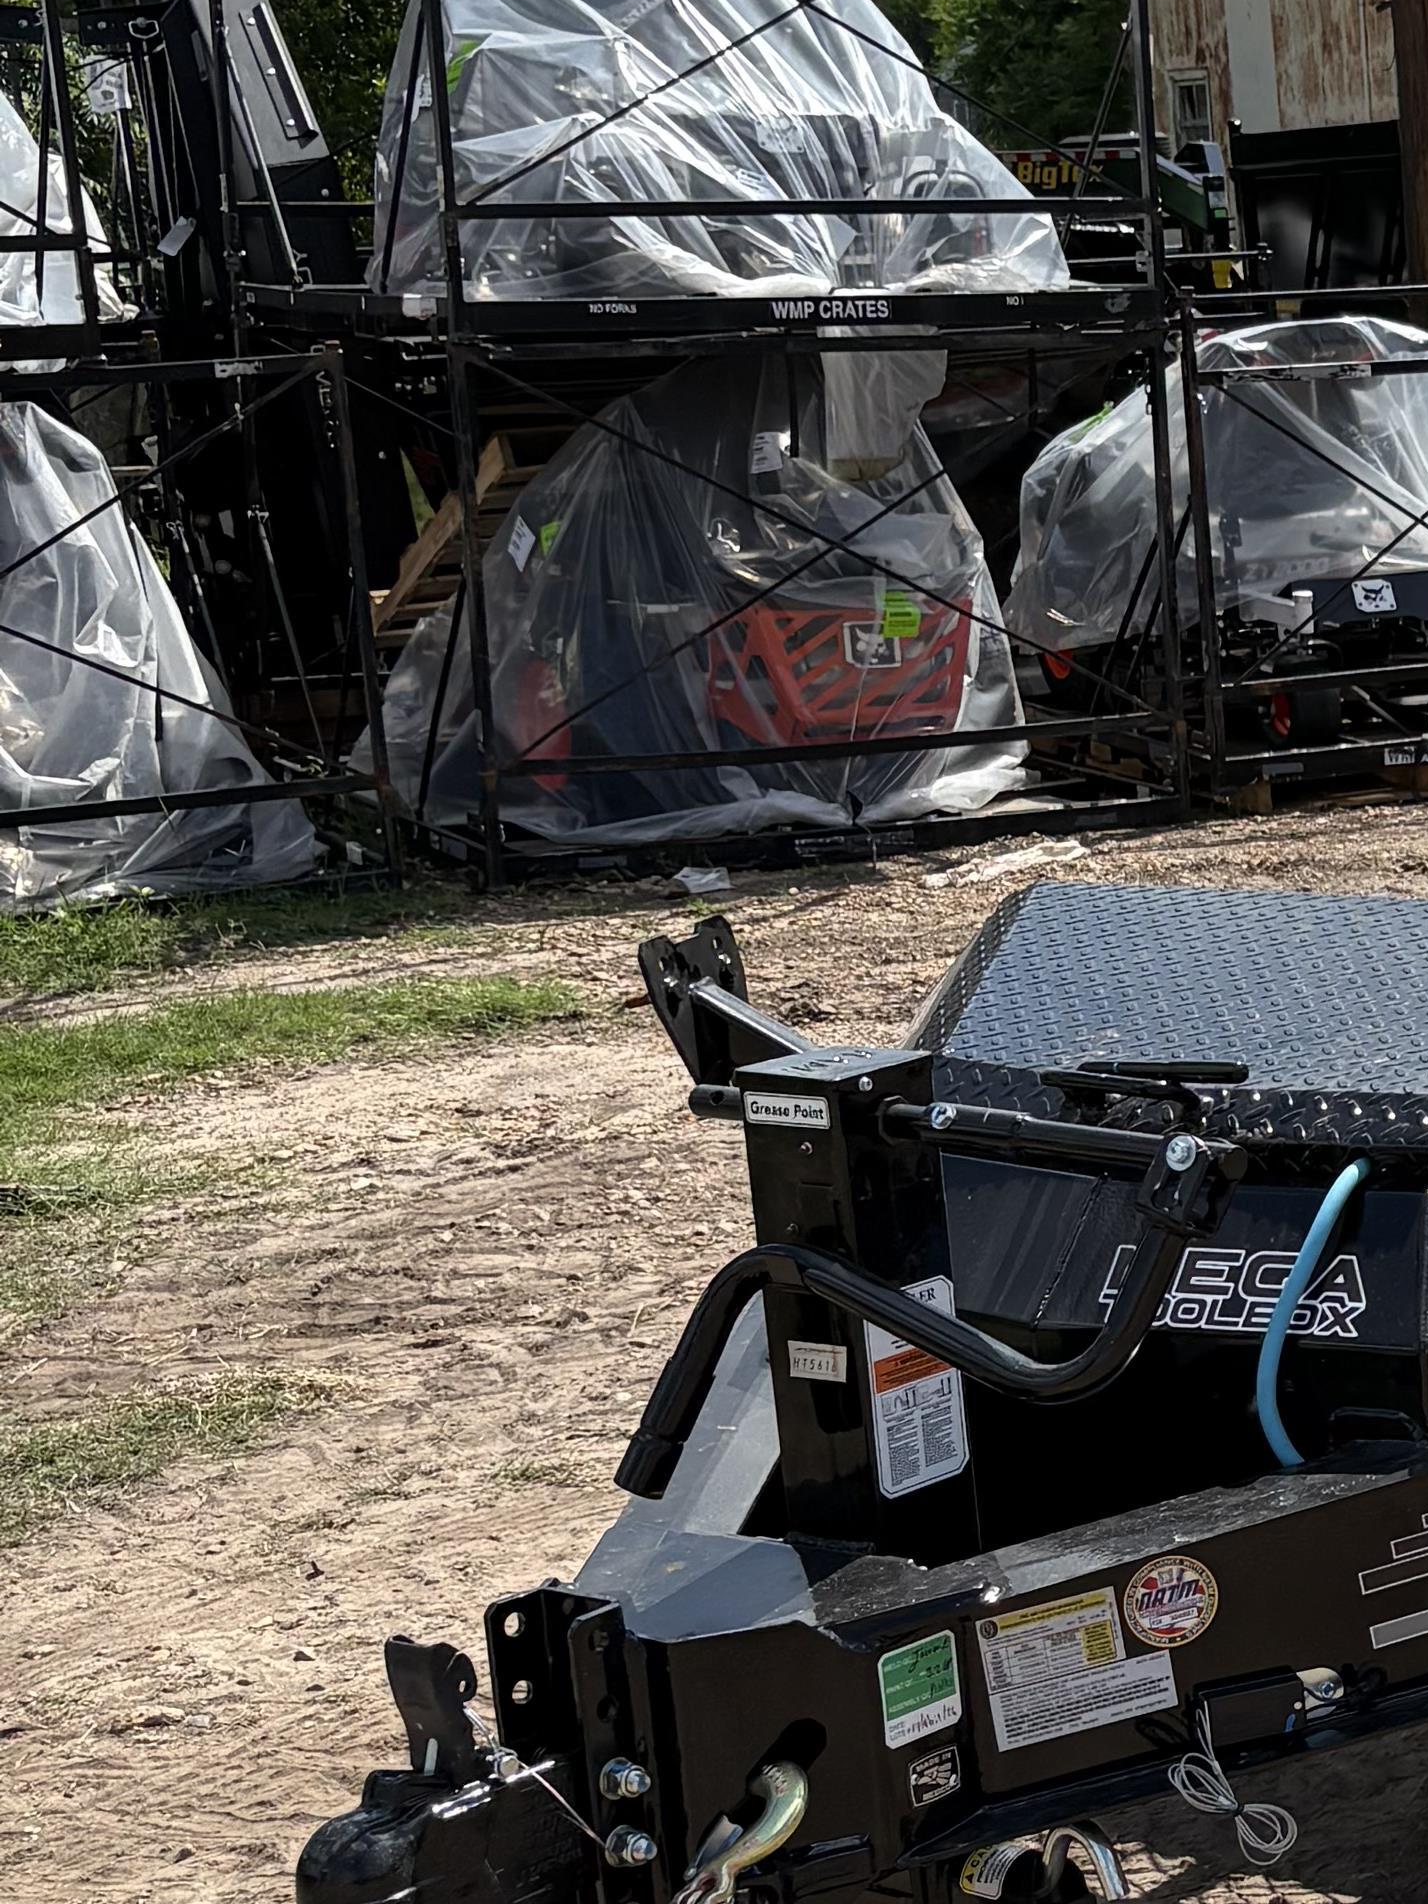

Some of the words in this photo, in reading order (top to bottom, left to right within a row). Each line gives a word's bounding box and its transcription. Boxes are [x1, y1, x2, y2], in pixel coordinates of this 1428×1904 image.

[772, 301, 814, 320] WMP
[820, 300, 889, 319] CRATES
[751, 1100, 790, 1118] Grease
[793, 1103, 824, 1121] Point
